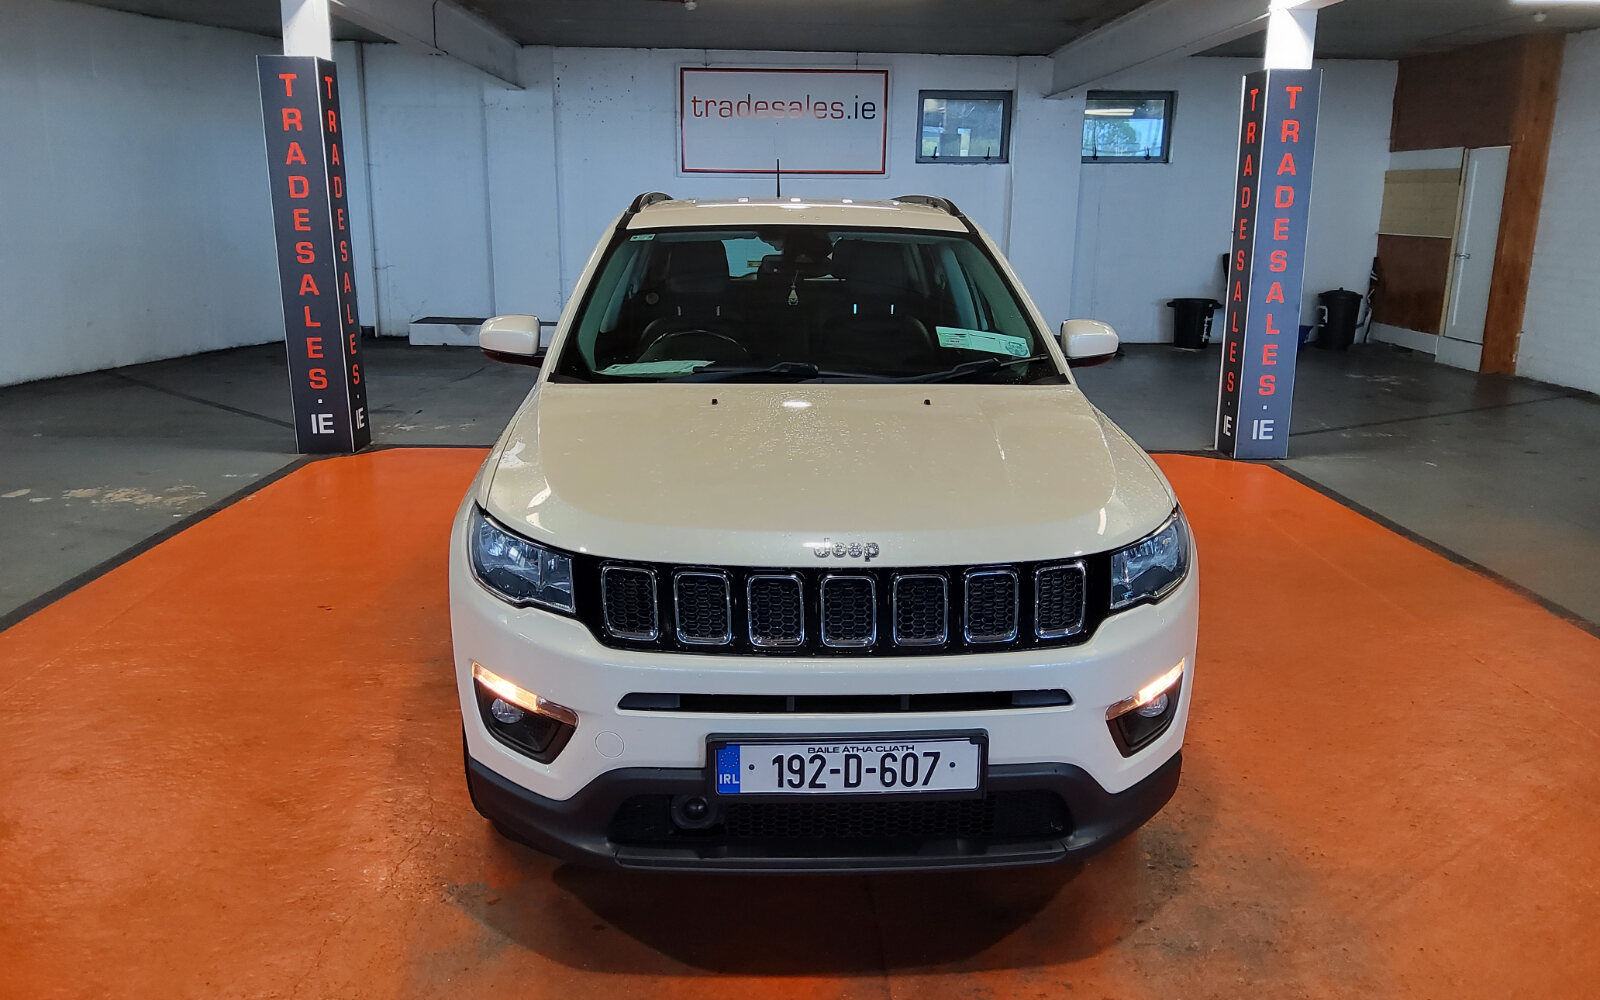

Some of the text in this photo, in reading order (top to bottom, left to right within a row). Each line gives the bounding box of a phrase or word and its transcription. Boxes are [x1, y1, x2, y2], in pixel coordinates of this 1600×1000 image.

[691, 93, 876, 120] tradesales.ie
[813, 537, 880, 562] Jeep
[807, 746, 840, 754] BAILE
[875, 744, 915, 752] CLIATH
[719, 773, 740, 785] IRL
[771, 751, 941, 789] 192-D-607
